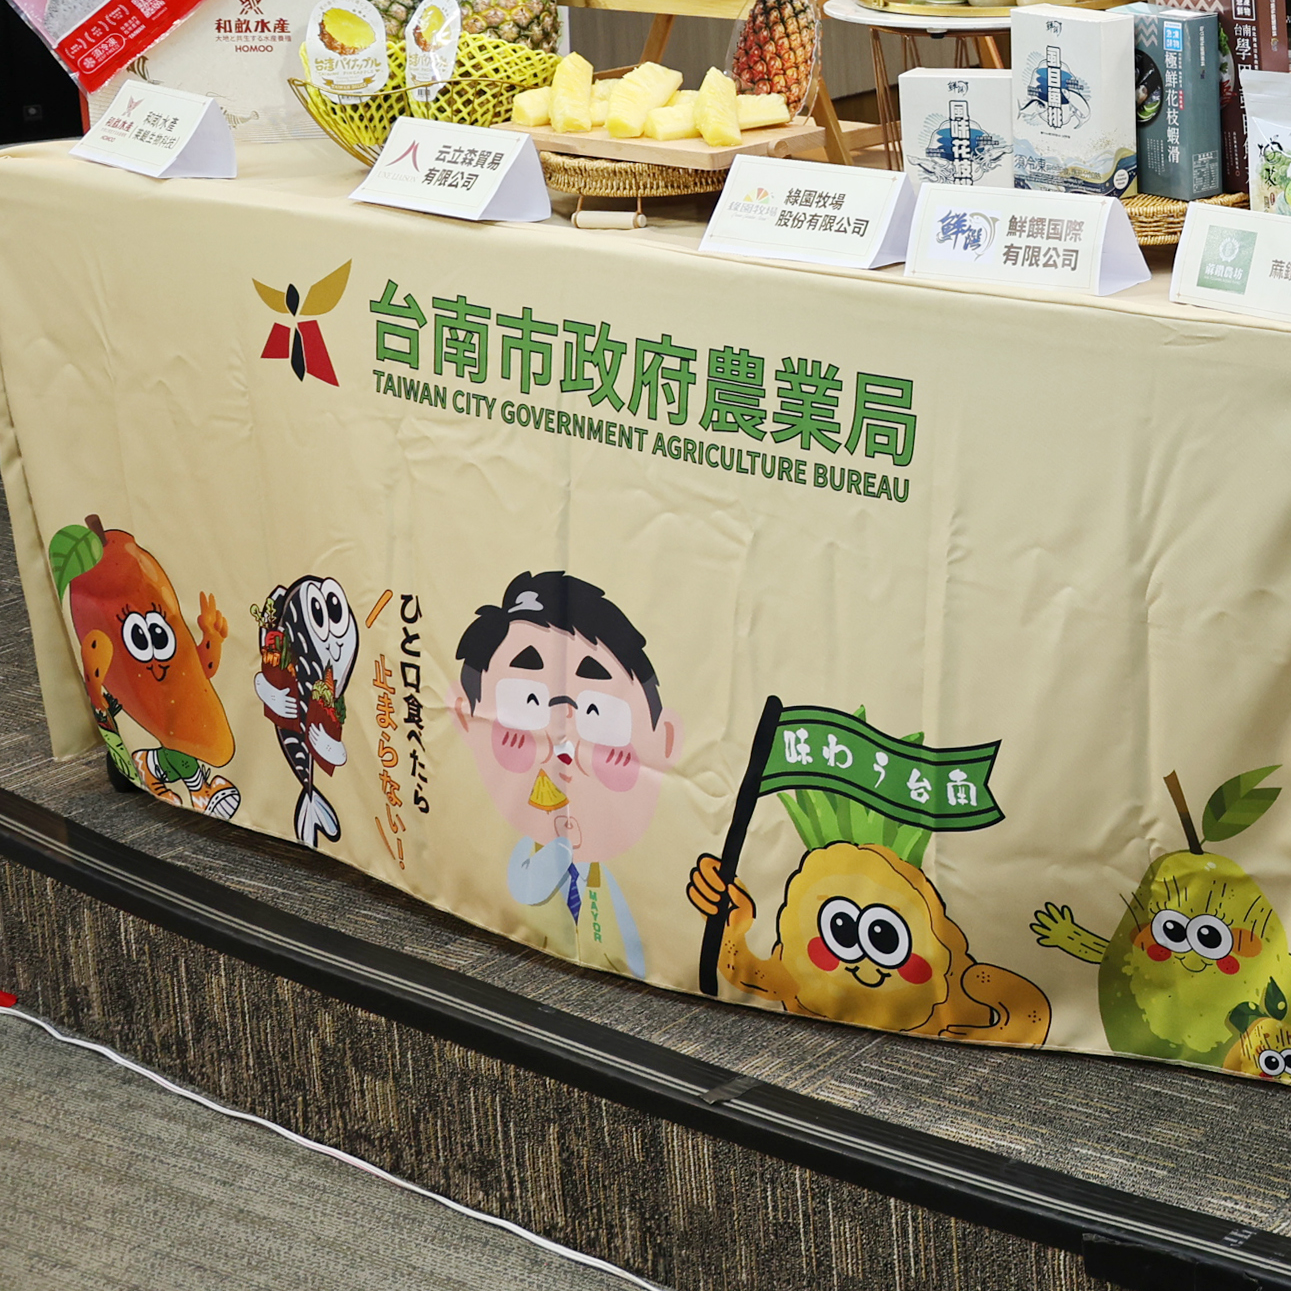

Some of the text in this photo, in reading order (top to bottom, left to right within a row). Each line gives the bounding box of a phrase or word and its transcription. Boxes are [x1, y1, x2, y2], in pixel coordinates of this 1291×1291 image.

[235, 44, 274, 53] HOMOO
[1164, 52, 1180, 164] 極鮮花枝蝦滑
[421, 166, 479, 192] 有限公司
[434, 144, 505, 171] 云立森貿易
[783, 187, 846, 212] 綠園牧場
[774, 208, 871, 239] 股份有限公司
[1001, 242, 1080, 273] 有限公司
[369, 278, 918, 469] 台南市政府農業局
[373, 369, 910, 505] TAIWAN CITY GOVERNMENT AGRICULTURE BUREAU
[399, 593, 430, 815] ひと口食べたら
[782, 727, 978, 807] 味わう台南
[588, 888, 603, 944] MAYOR
